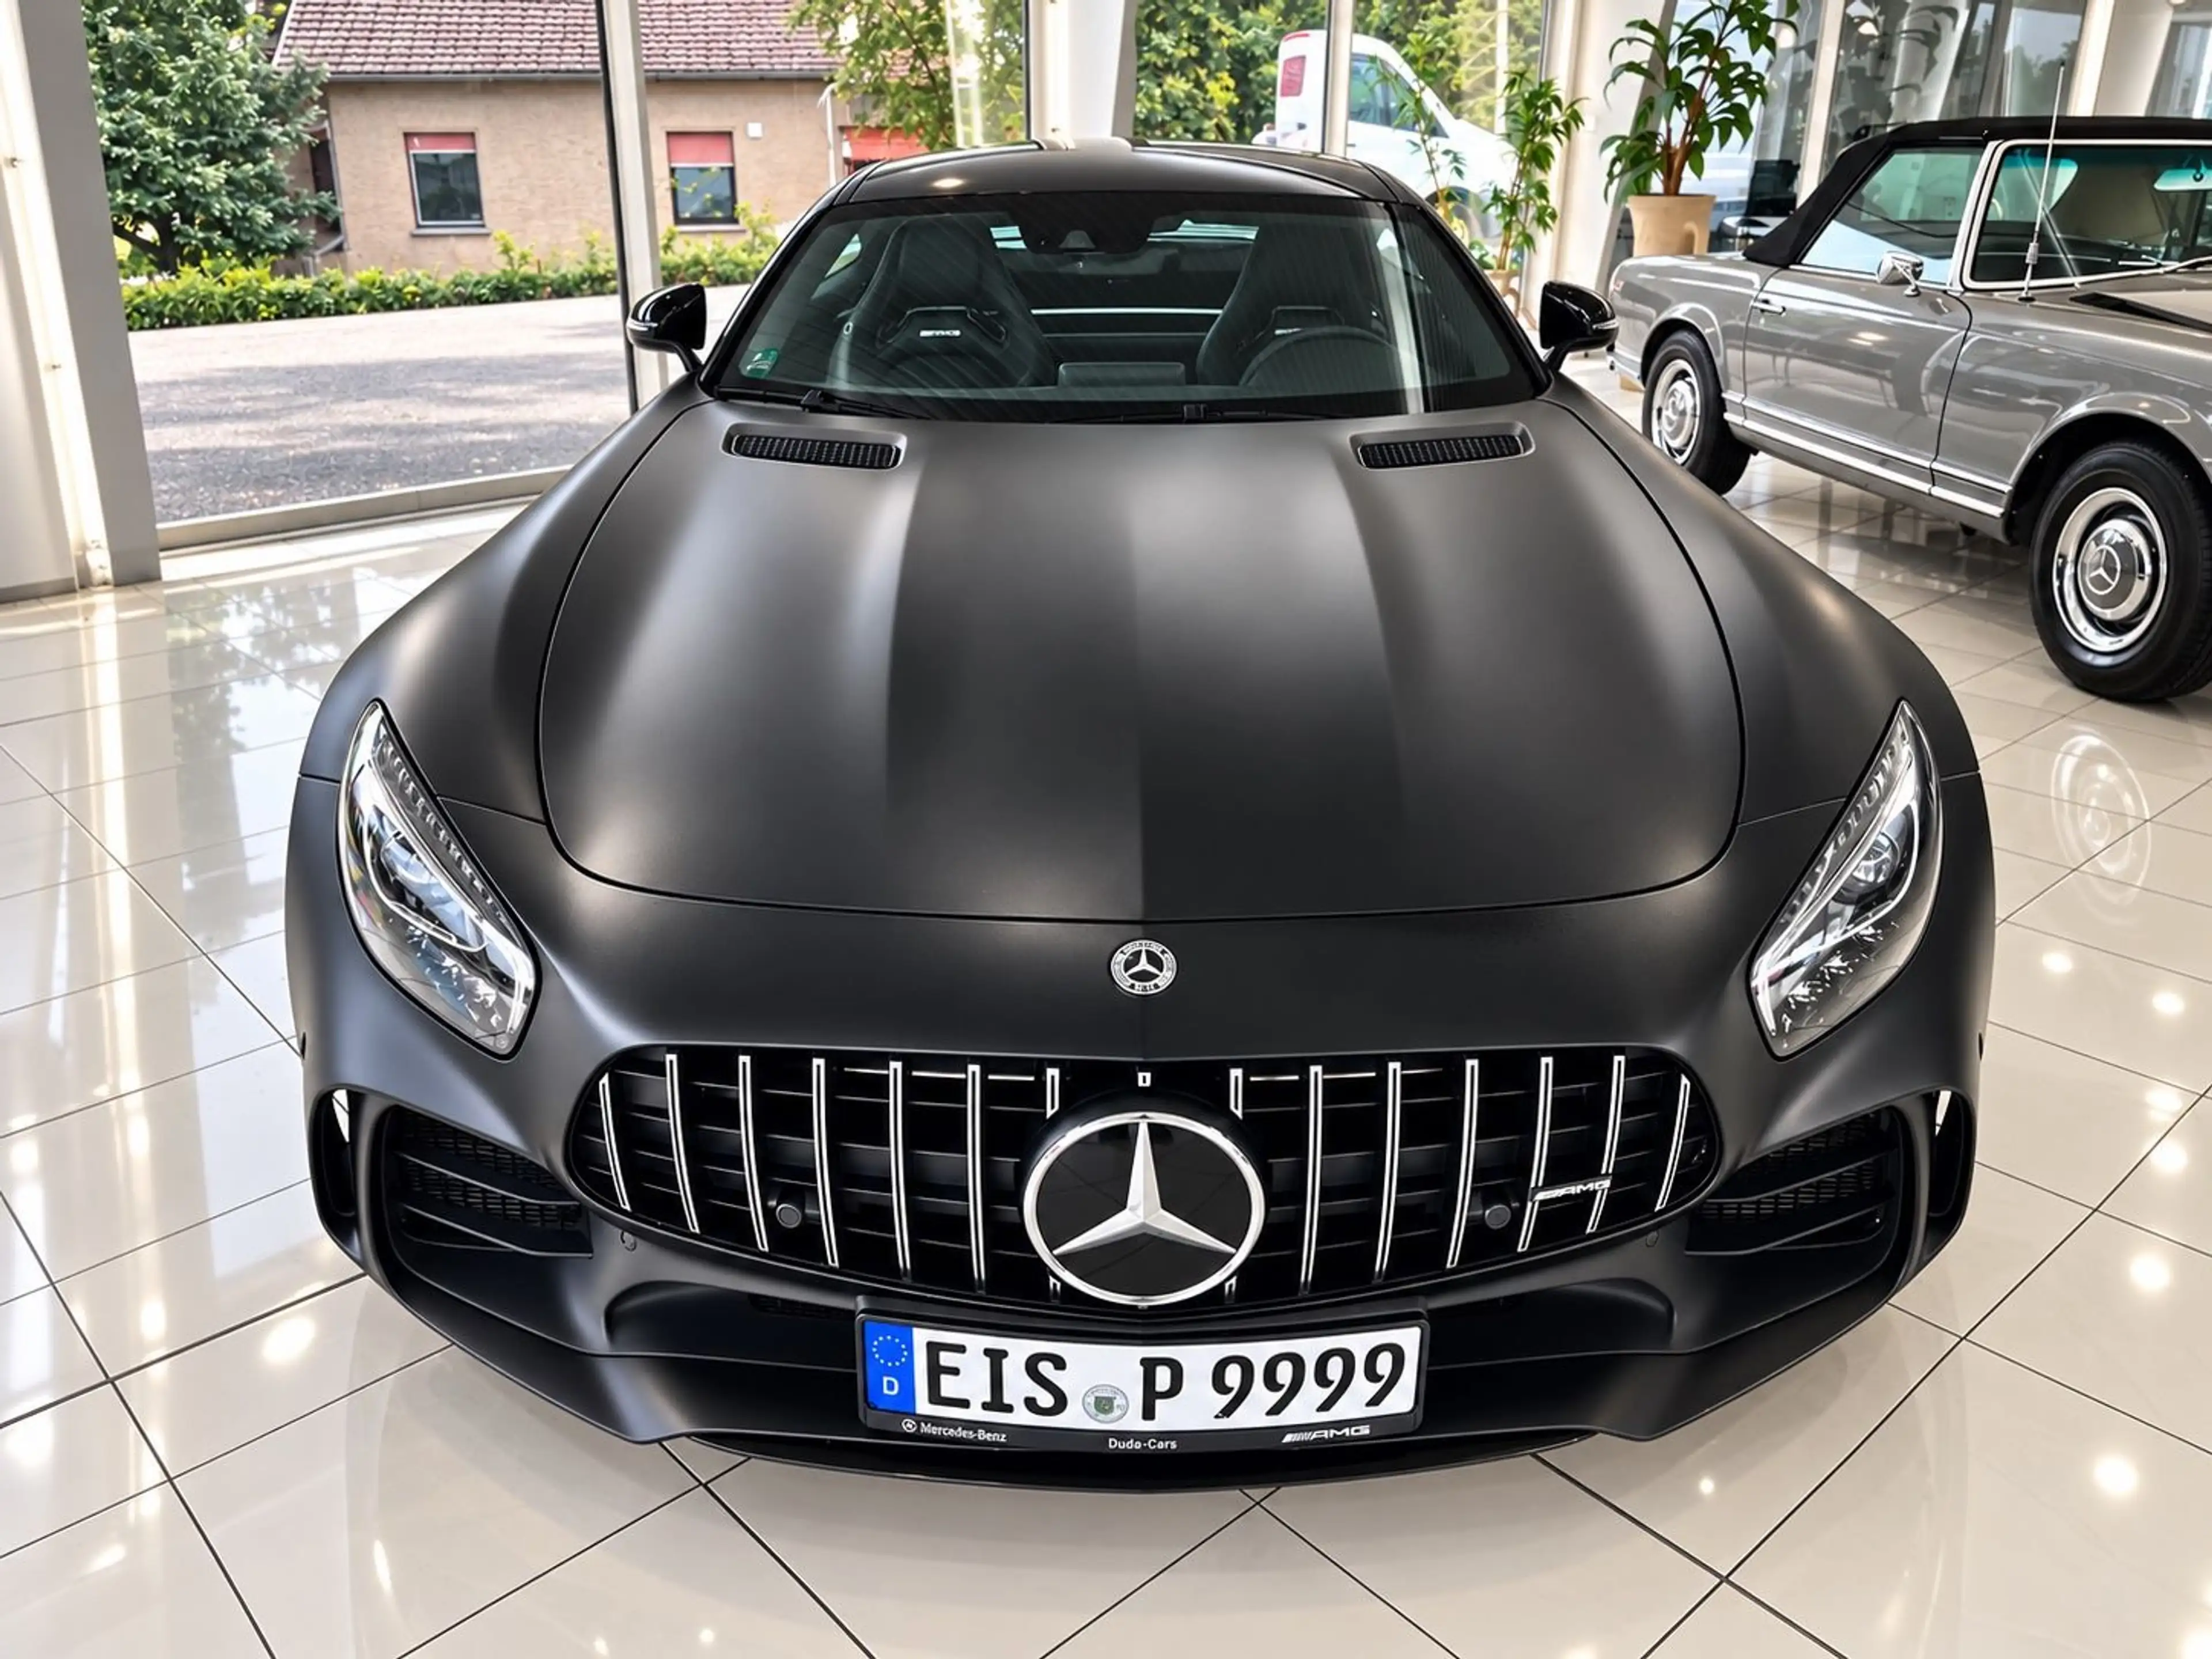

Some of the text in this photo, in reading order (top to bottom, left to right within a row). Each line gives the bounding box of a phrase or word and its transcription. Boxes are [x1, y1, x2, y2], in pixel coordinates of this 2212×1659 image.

[1555, 1179, 1611, 1196] AMG
[882, 1376, 899, 1396] D
[926, 1341, 1068, 1416] EIS
[1139, 1357, 1183, 1421] P
[1211, 1343, 1405, 1419] 9999
[920, 1422, 1007, 1442] Mercedes-Benz
[1308, 1425, 1370, 1440] AMG
